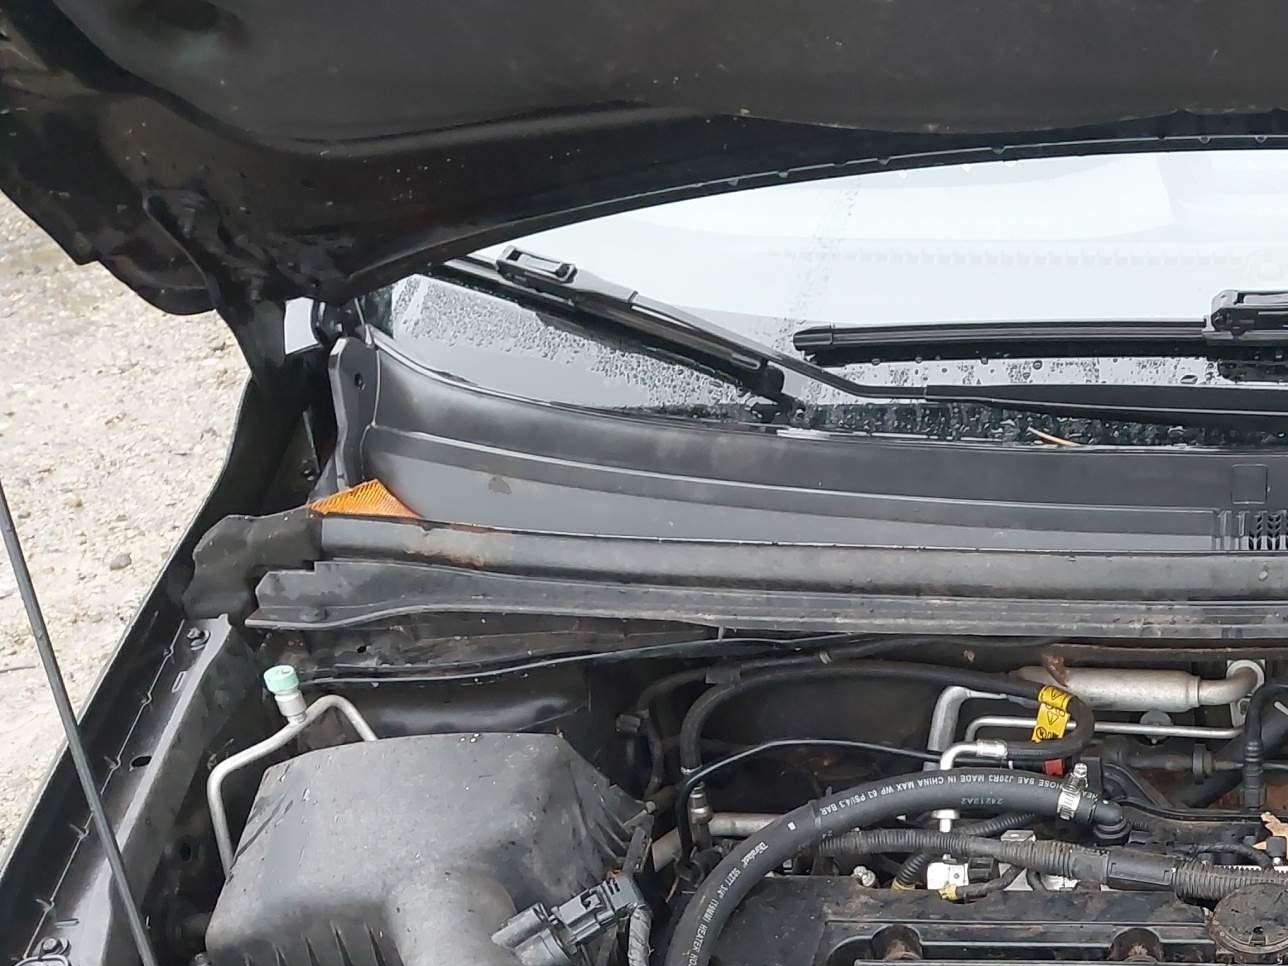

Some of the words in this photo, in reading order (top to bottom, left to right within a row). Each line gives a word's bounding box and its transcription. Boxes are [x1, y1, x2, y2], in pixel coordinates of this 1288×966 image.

[917, 776, 944, 788] CHINA
[947, 775, 957, 784] IN
[960, 774, 985, 783] MADE
[988, 774, 1014, 784] J20R3
[1018, 776, 1035, 785] SAE
[895, 781, 915, 792] MAX
[1039, 779, 1063, 790] HOSE
[880, 785, 895, 796] WP
[820, 803, 838, 816] BAR
[691, 923, 708, 953] HEATER
